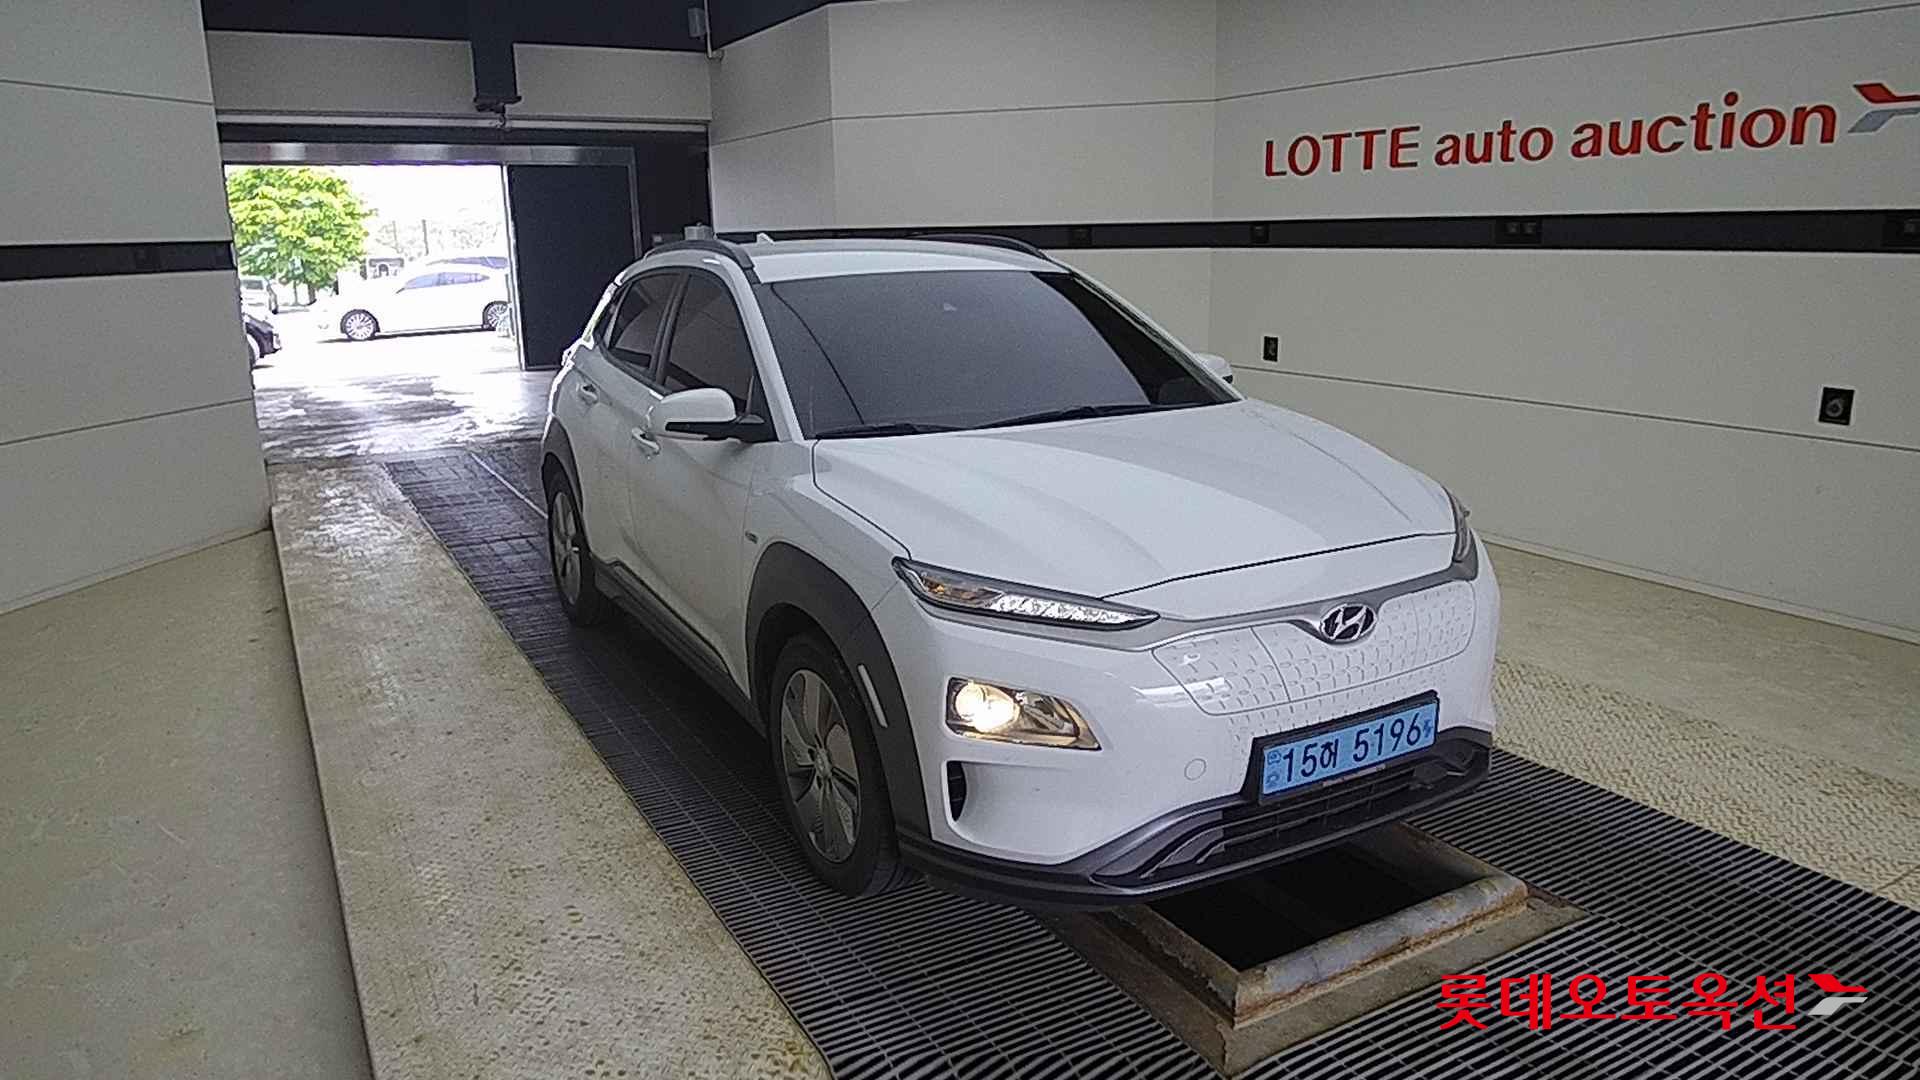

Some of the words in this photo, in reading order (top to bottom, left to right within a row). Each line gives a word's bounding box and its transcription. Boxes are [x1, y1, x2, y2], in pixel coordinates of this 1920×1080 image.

[1265, 126, 1421, 177] LOTTE
[1434, 119, 1554, 167] auto
[1570, 91, 1838, 160] auction
[1282, 738, 1339, 783] 15허
[1352, 712, 1421, 762] 5196
